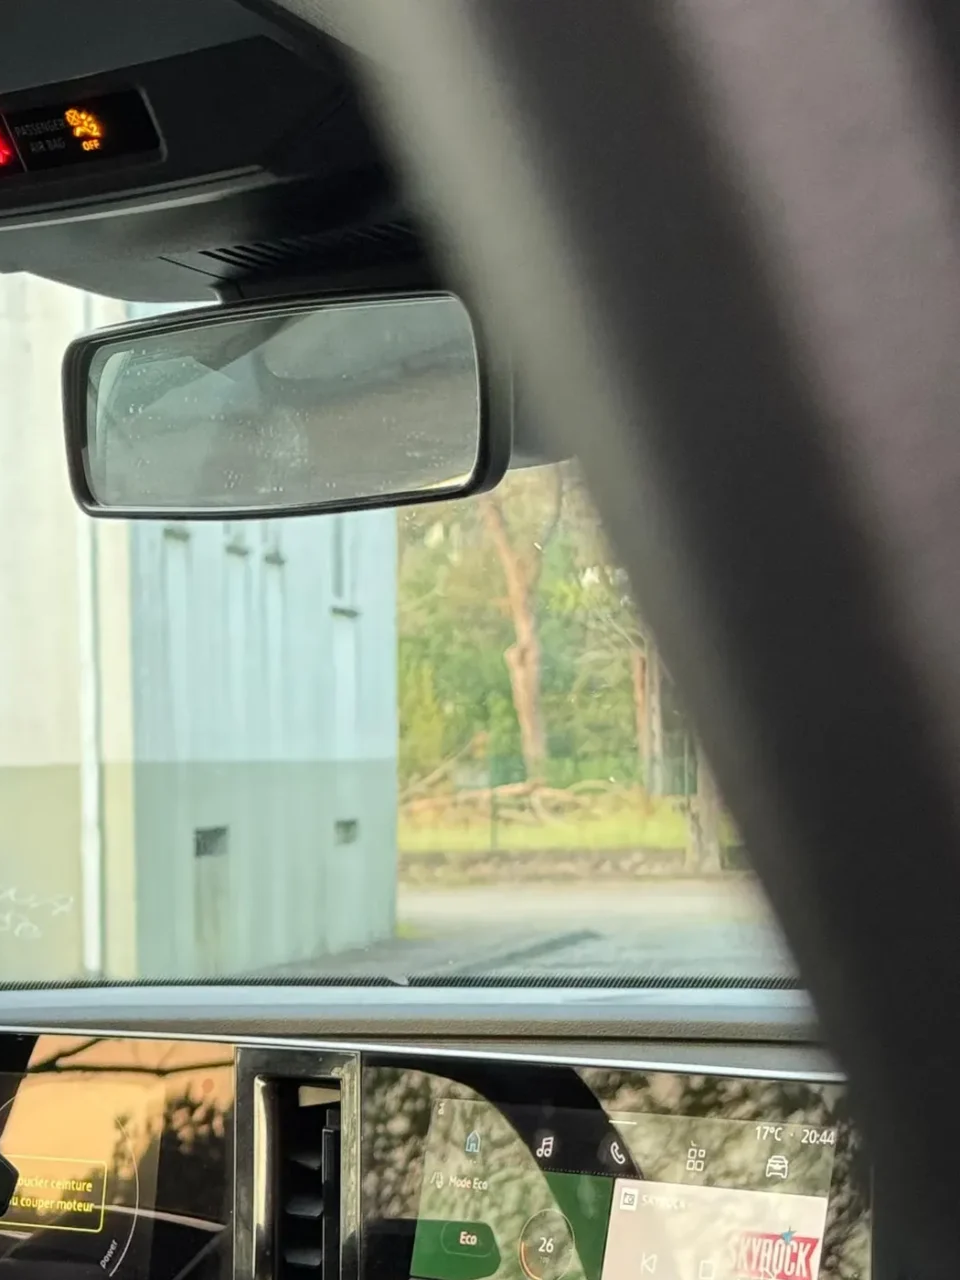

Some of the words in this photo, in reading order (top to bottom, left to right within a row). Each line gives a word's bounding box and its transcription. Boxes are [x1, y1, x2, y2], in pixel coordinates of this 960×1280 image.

[14, 119, 66, 137] PASSENGER
[81, 139, 100, 151] OFF
[801, 1129, 836, 1145] 20:44
[51, 1178, 93, 1192] ceinture
[448, 1176, 471, 1189] Mode
[472, 1179, 488, 1190] Eco
[20, 1197, 55, 1210] couper
[56, 1198, 95, 1212] moteur
[459, 1231, 478, 1246] Eco
[538, 1236, 554, 1253] 26
[100, 1239, 118, 1269] power
[727, 1234, 812, 1278] SKYROCK
